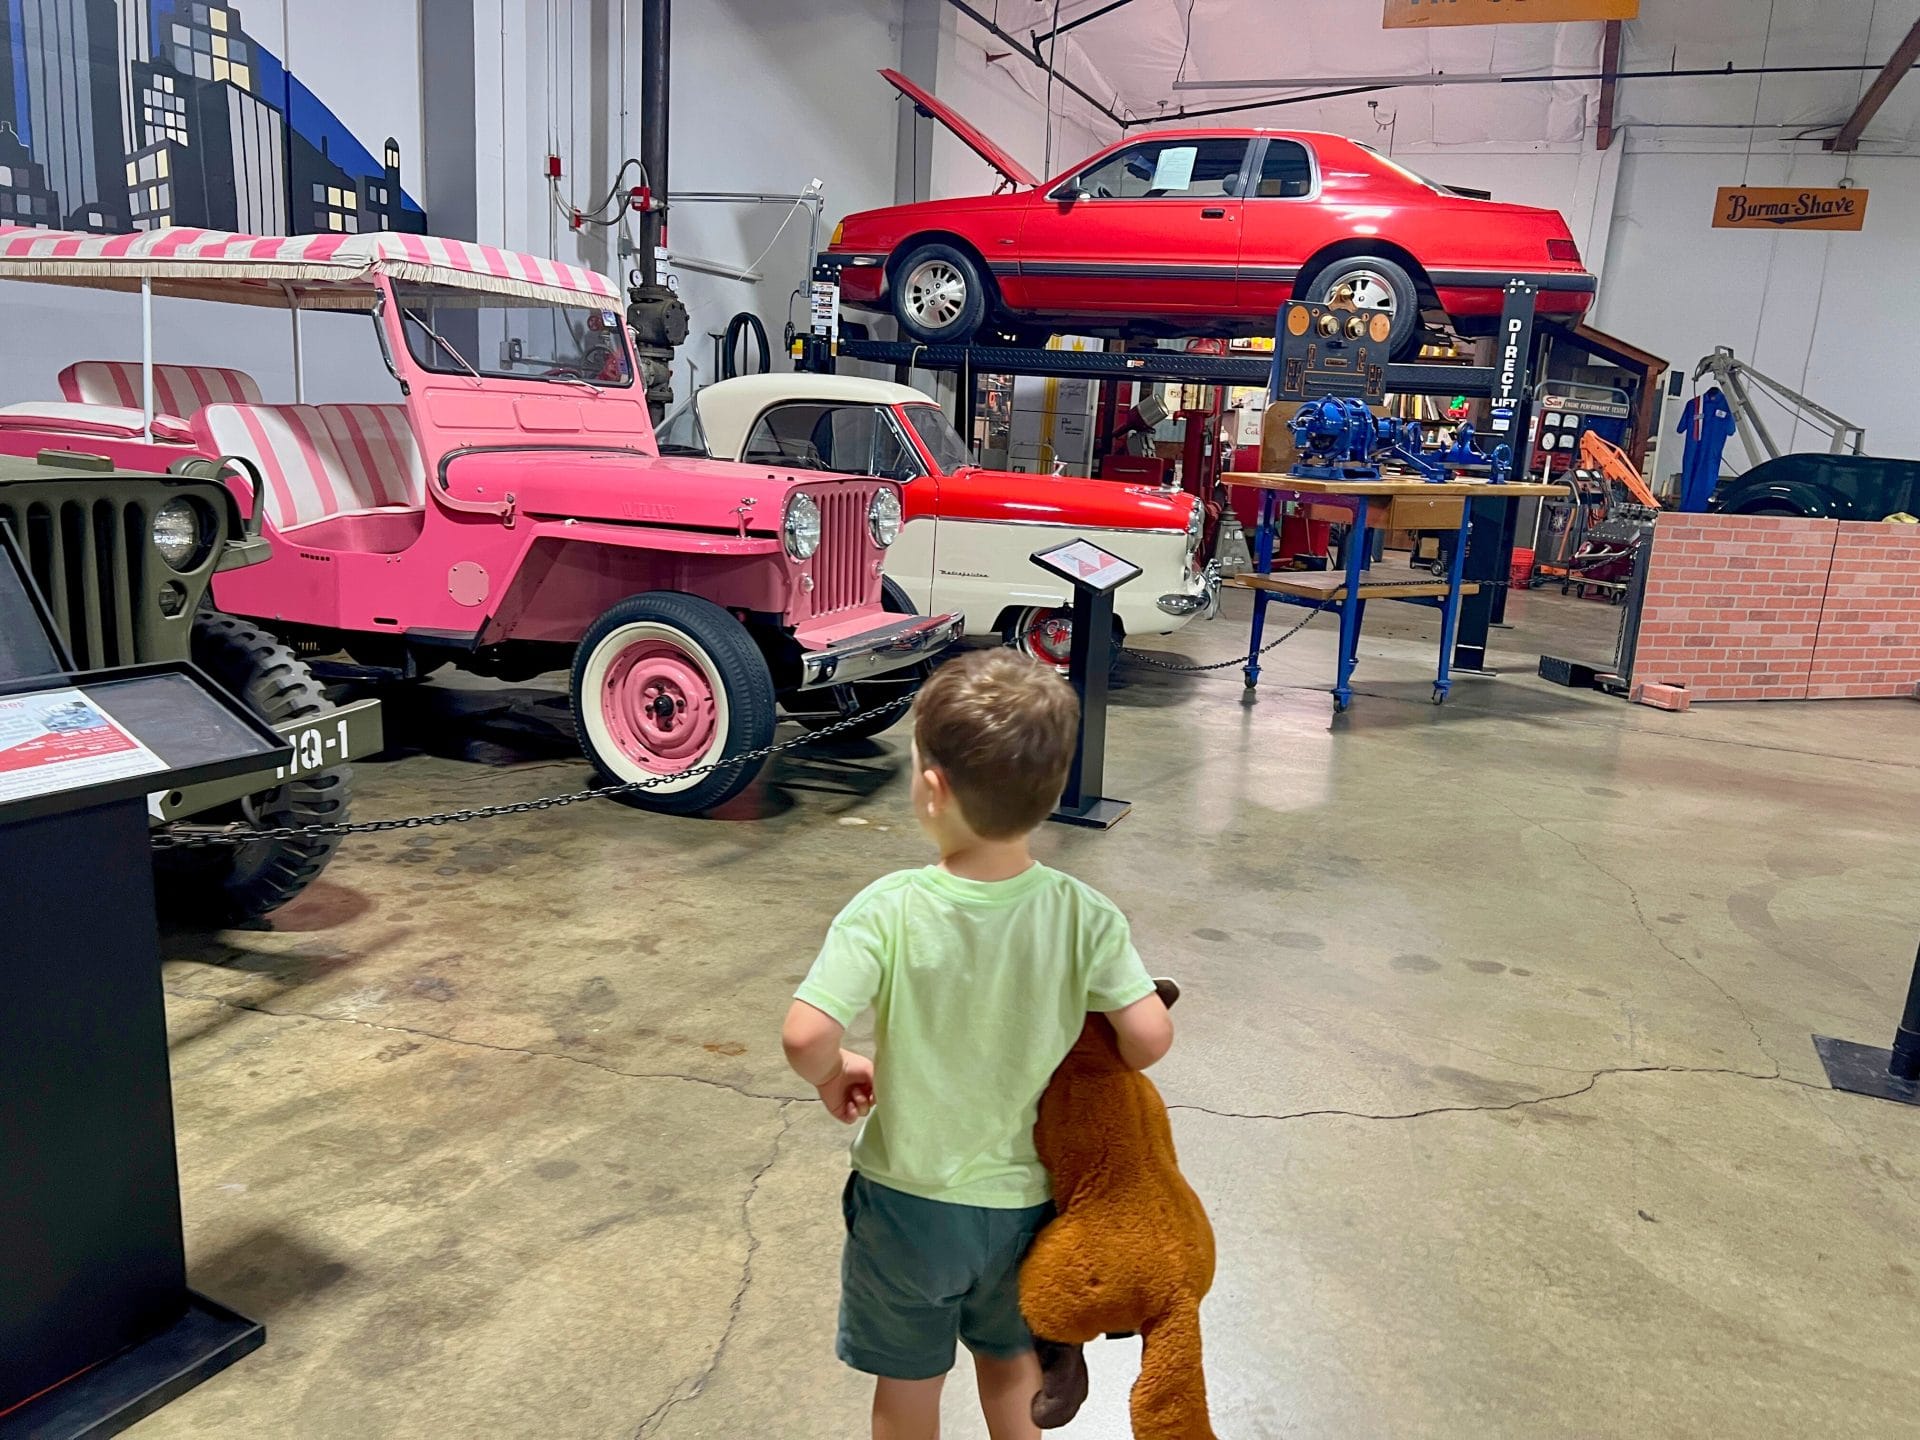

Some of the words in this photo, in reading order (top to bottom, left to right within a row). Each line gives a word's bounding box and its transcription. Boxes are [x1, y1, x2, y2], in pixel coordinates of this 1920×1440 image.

[1726, 193, 1855, 222] Burma-Shave
[1500, 318, 1522, 398] DIRECT
[1491, 397, 1518, 408] LIFT
[1580, 403, 1610, 412] PERFORMANCE
[1611, 406, 1627, 414] TESTER
[1245, 427, 1260, 435] Cok
